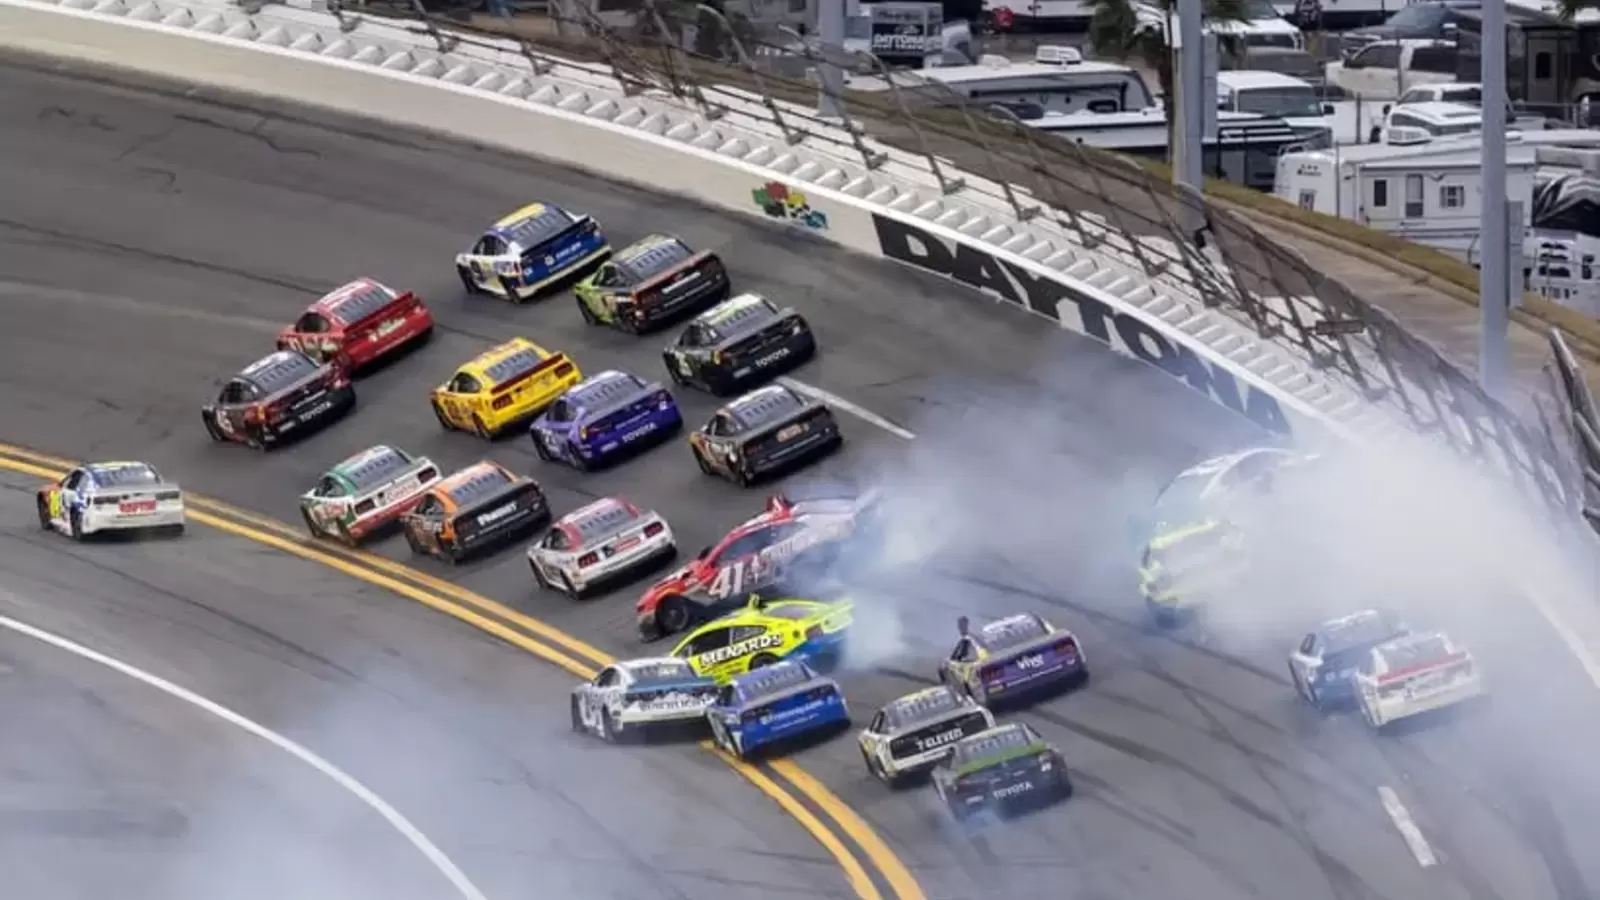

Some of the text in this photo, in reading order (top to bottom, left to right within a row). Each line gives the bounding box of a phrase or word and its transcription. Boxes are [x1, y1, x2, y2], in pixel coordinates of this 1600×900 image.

[872, 213, 1290, 433] DAYTONA
[755, 347, 791, 368] TOYOTA
[299, 401, 332, 422] TOYOTA
[622, 422, 657, 443] TOYOTA
[707, 561, 744, 600] 41
[701, 633, 783, 666] MENARDS
[992, 781, 1033, 799] TOYOTA
